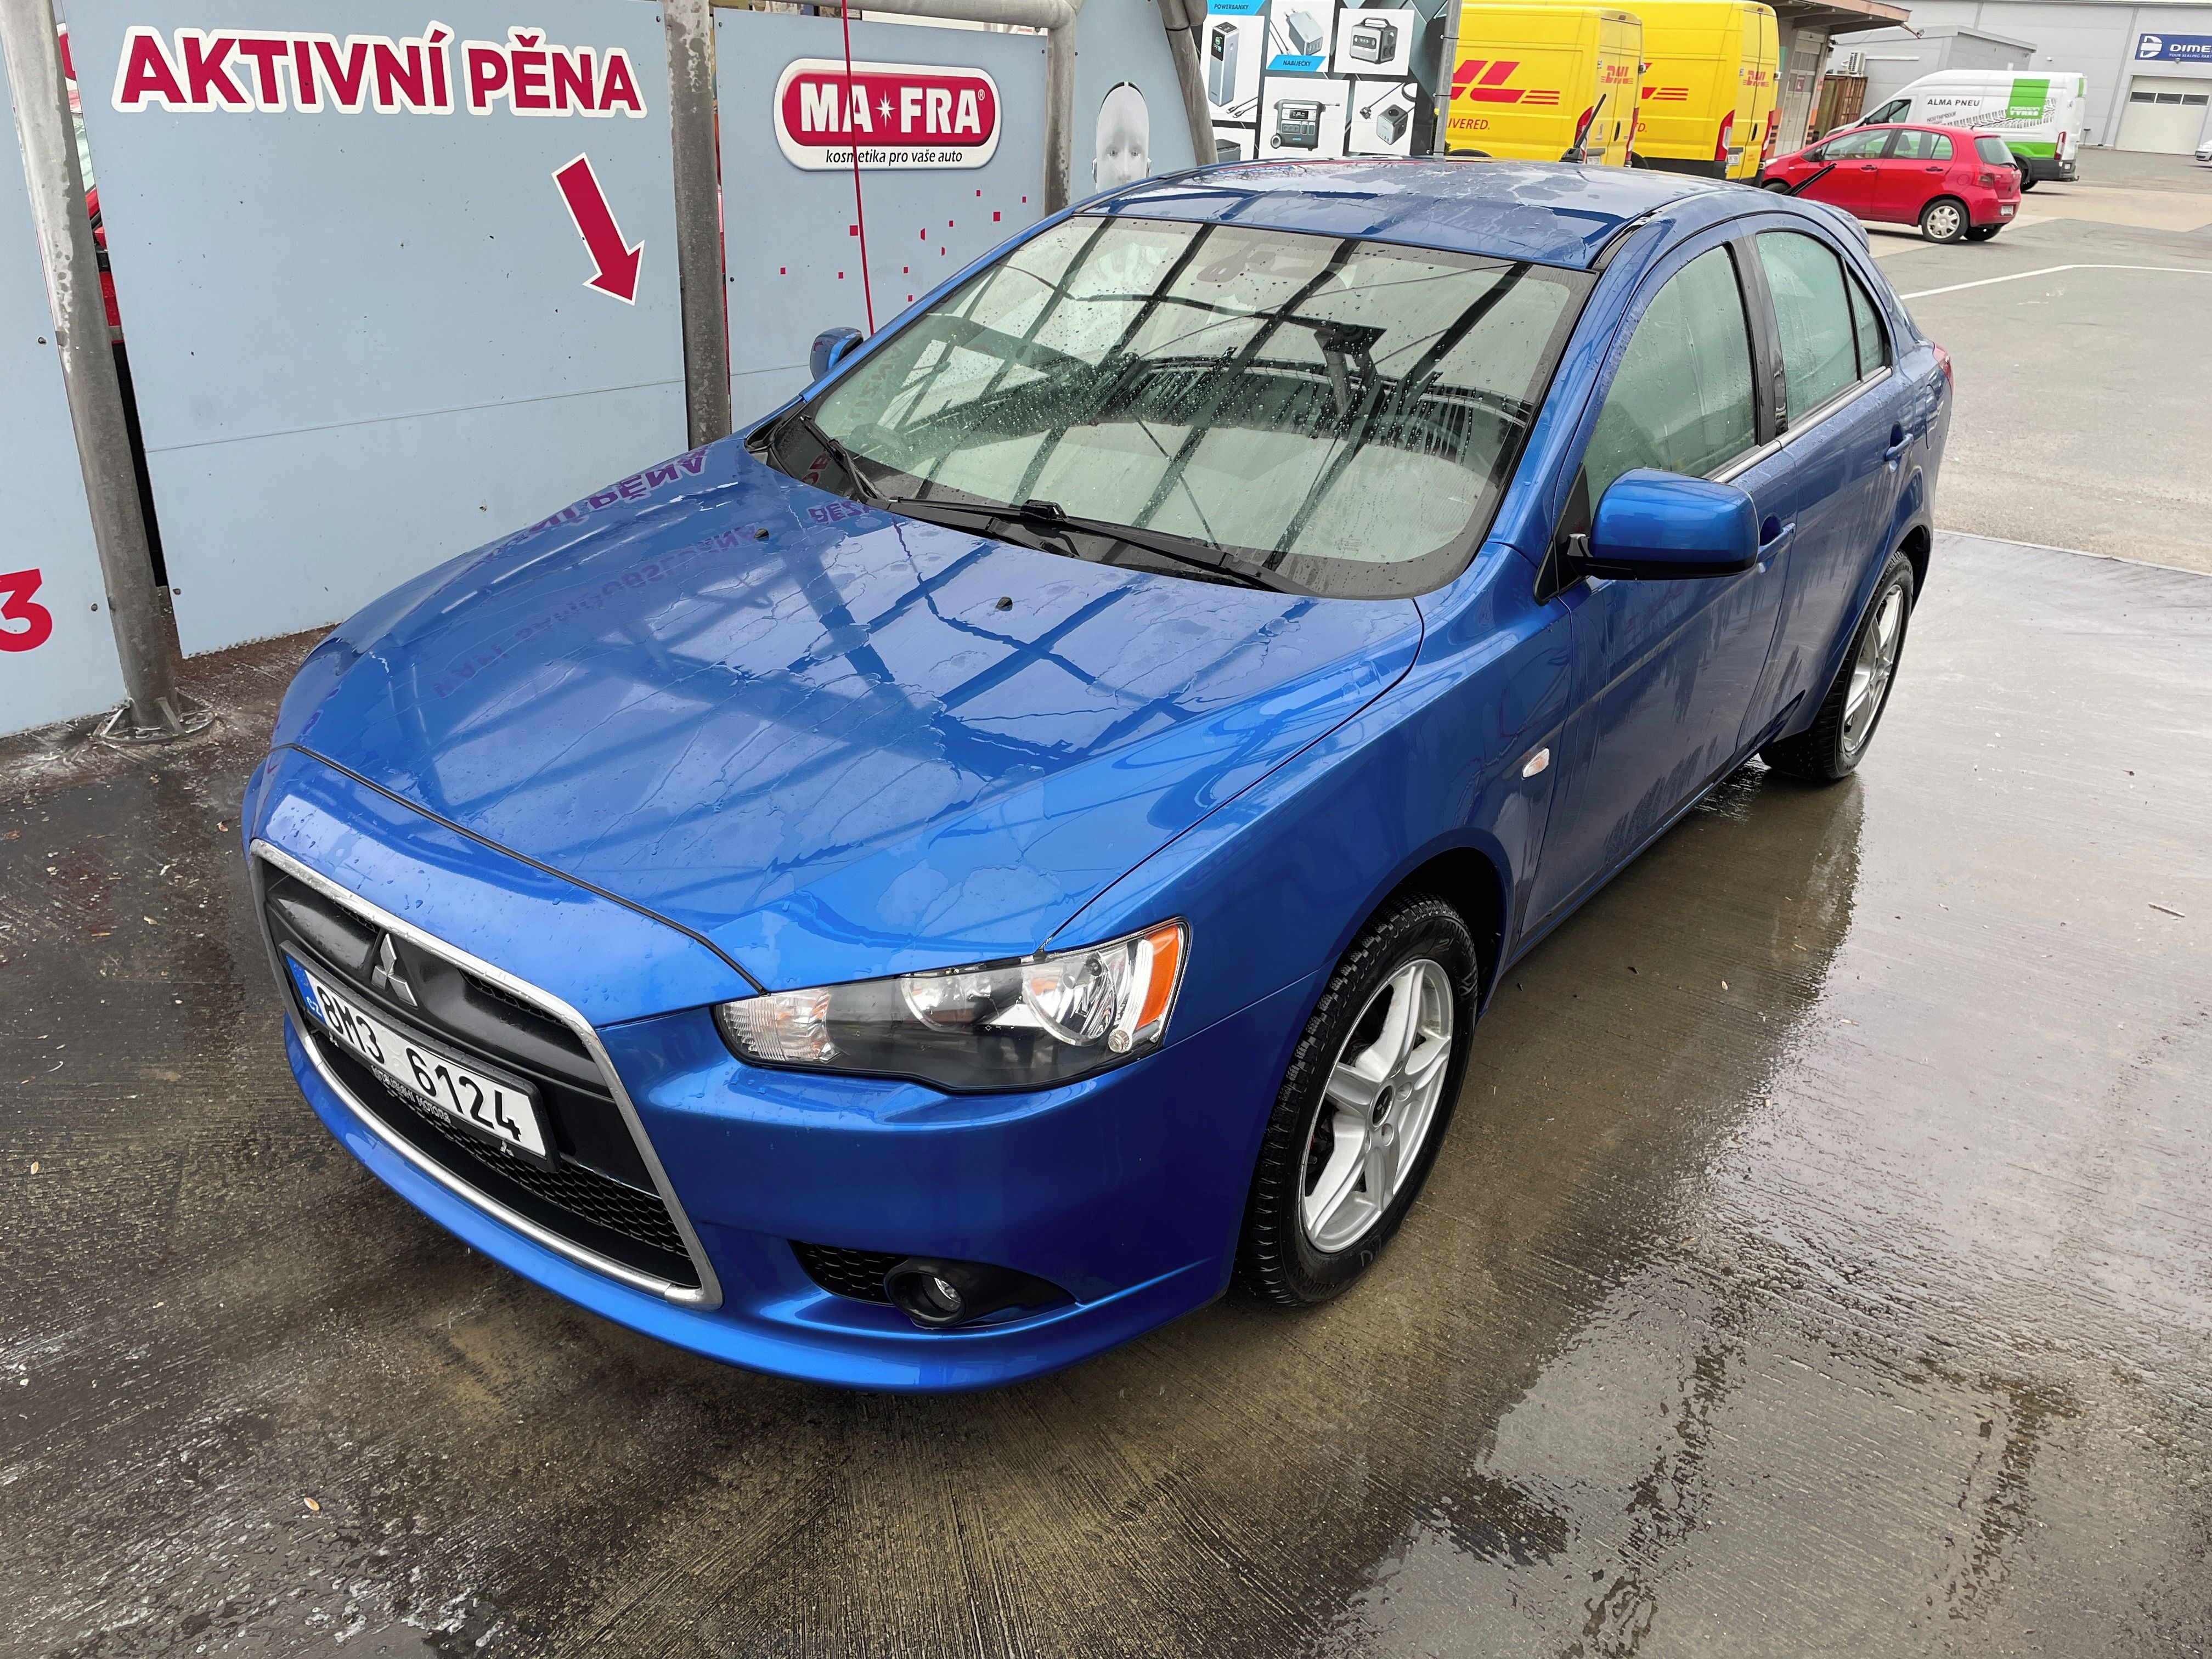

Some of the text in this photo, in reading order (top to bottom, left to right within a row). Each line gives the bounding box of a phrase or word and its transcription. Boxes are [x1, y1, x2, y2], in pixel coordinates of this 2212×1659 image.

[2170, 44, 2212, 53] DIME
[120, 29, 642, 111] AKTIVNÍ PĚNA
[1447, 118, 1490, 130] IVERED.
[889, 152, 909, 167] pro
[912, 149, 936, 163] vaše
[938, 150, 963, 163] auto
[0, 568, 53, 653] 3
[306, 996, 323, 1018] CZ
[317, 985, 522, 1143] 8M3 6124
